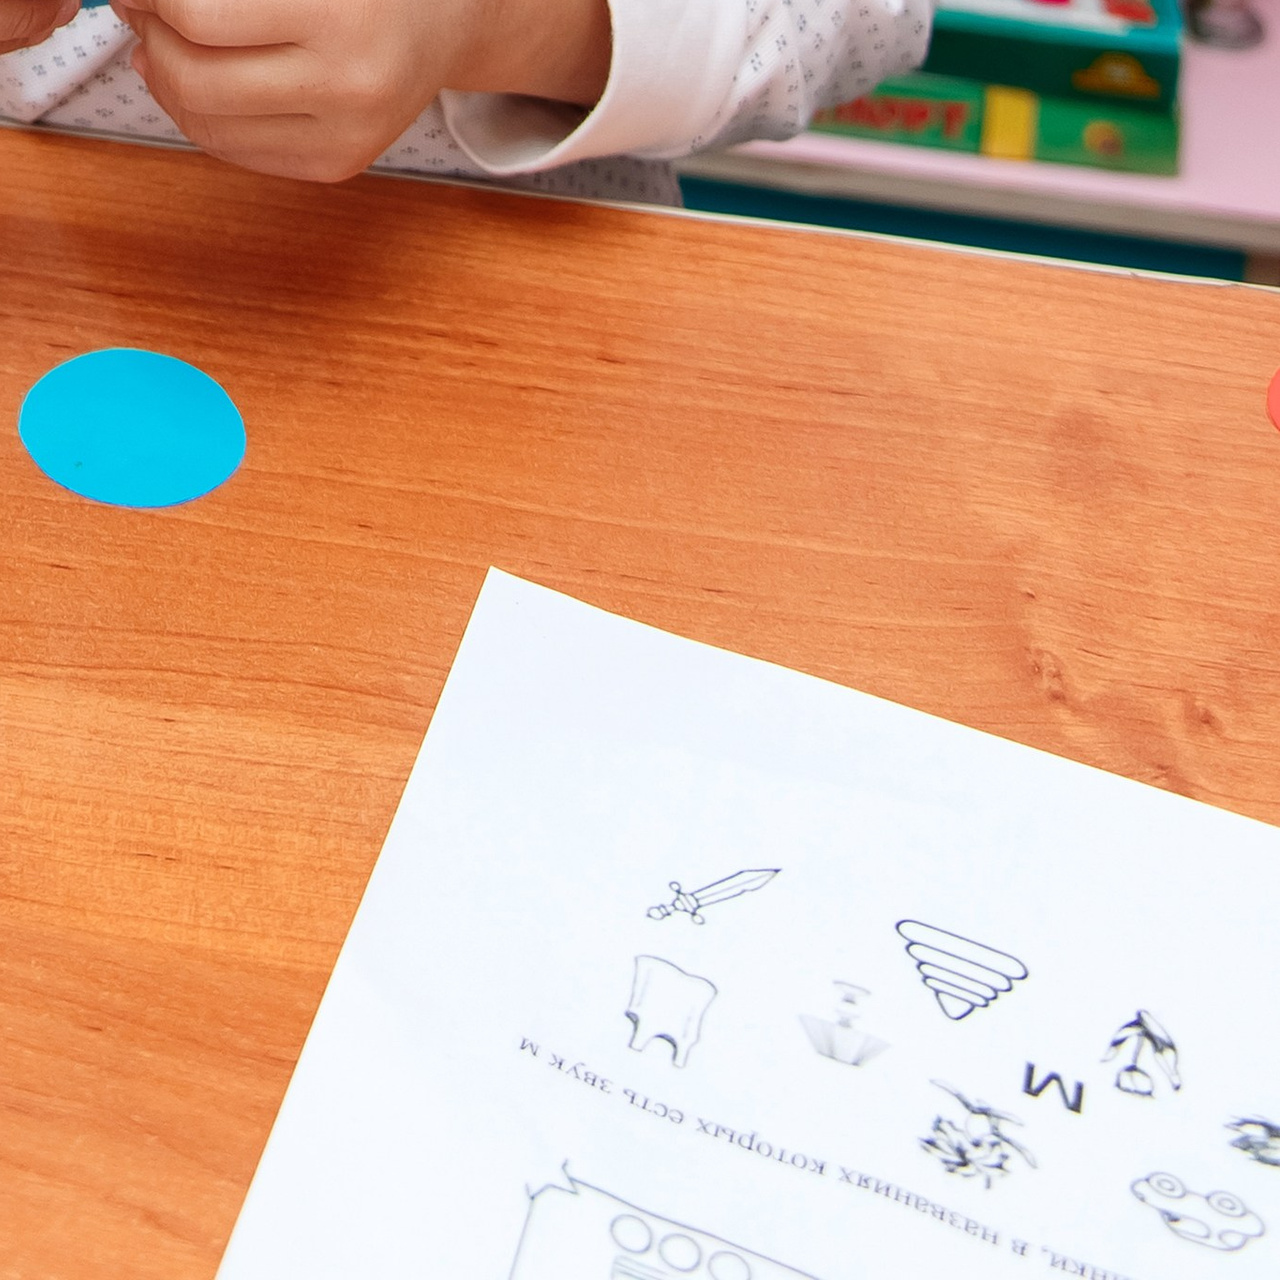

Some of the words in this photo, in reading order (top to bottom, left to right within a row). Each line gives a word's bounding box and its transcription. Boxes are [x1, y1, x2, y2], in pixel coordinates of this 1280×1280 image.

[548, 1053, 614, 1094] звук
[1023, 1061, 1084, 1114] М
[623, 1088, 685, 1125] есть
[696, 1118, 827, 1176] которых
[839, 1167, 1000, 1246] названиях
[1010, 1238, 1029, 1257] в
